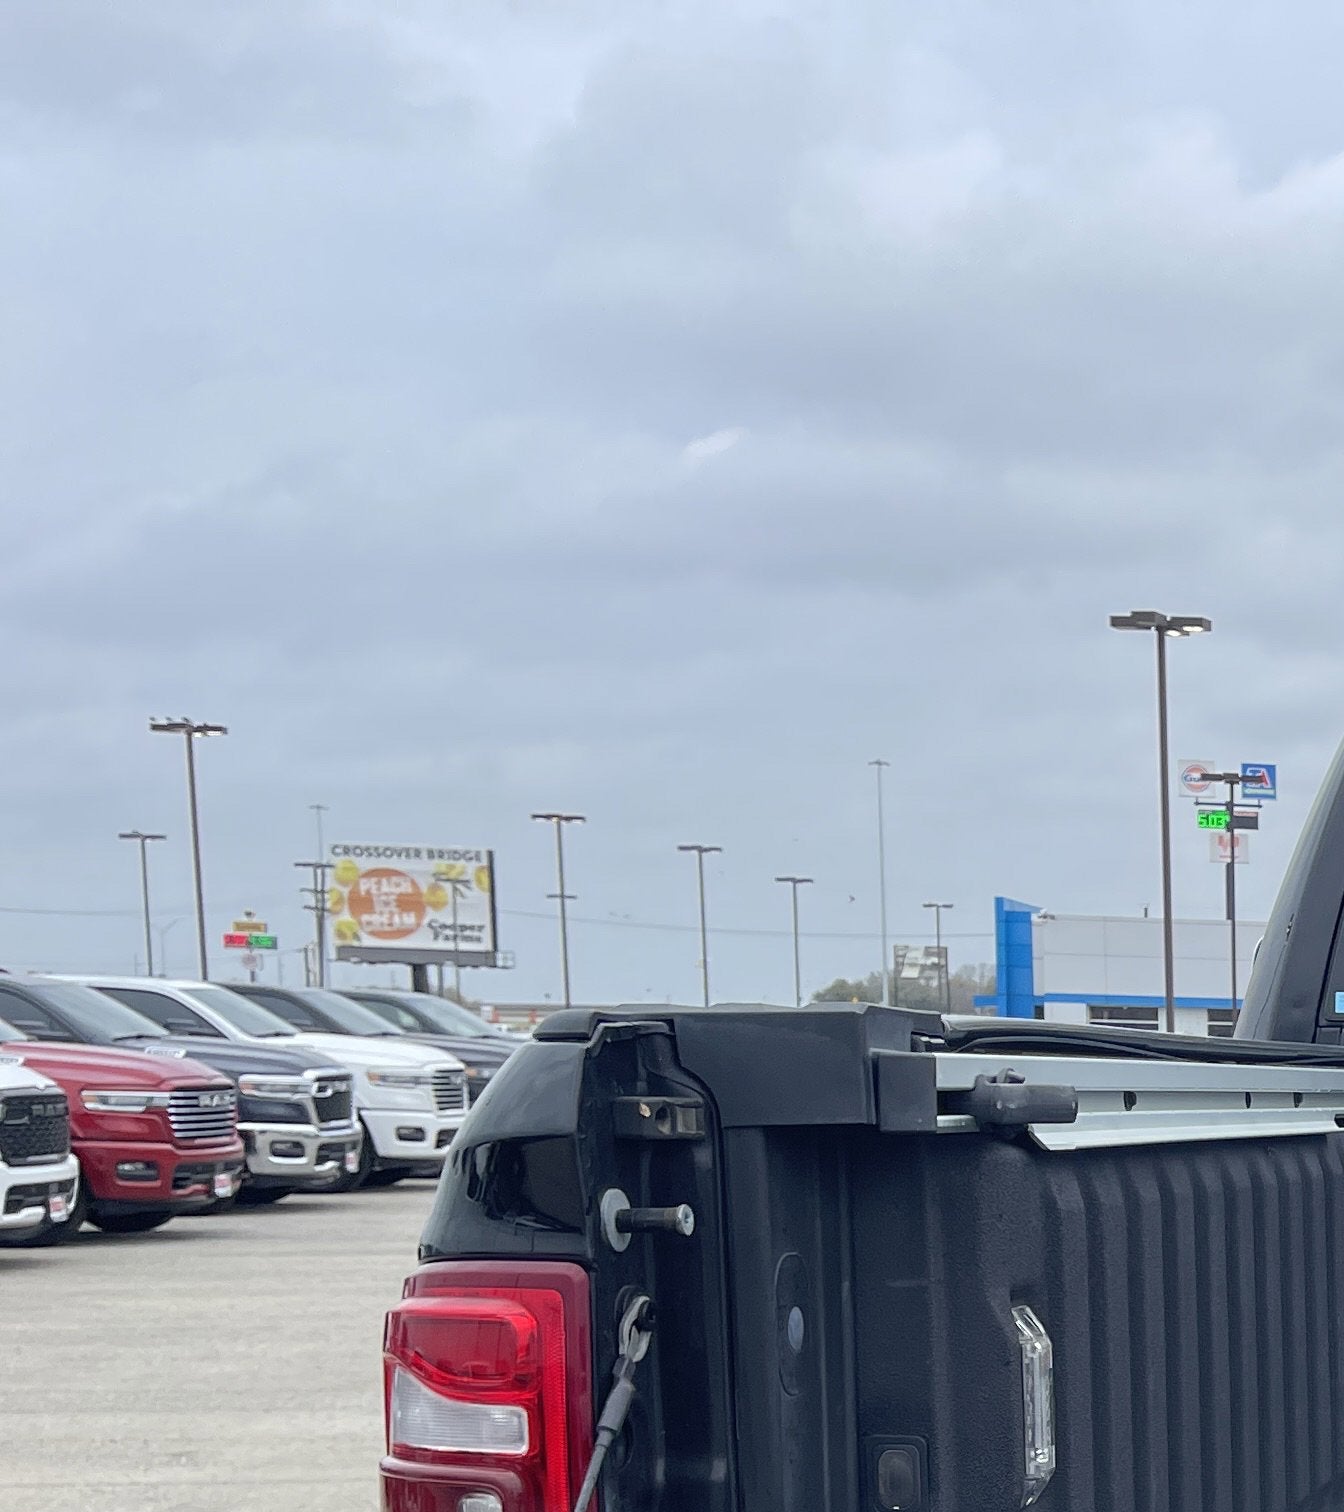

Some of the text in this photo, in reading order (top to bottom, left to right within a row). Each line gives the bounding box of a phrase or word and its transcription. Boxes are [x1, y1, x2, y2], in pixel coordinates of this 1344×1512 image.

[331, 844, 482, 862] CROSSOVER BRIDGE
[359, 876, 412, 895] PEACH
[360, 911, 417, 931] CREAM
